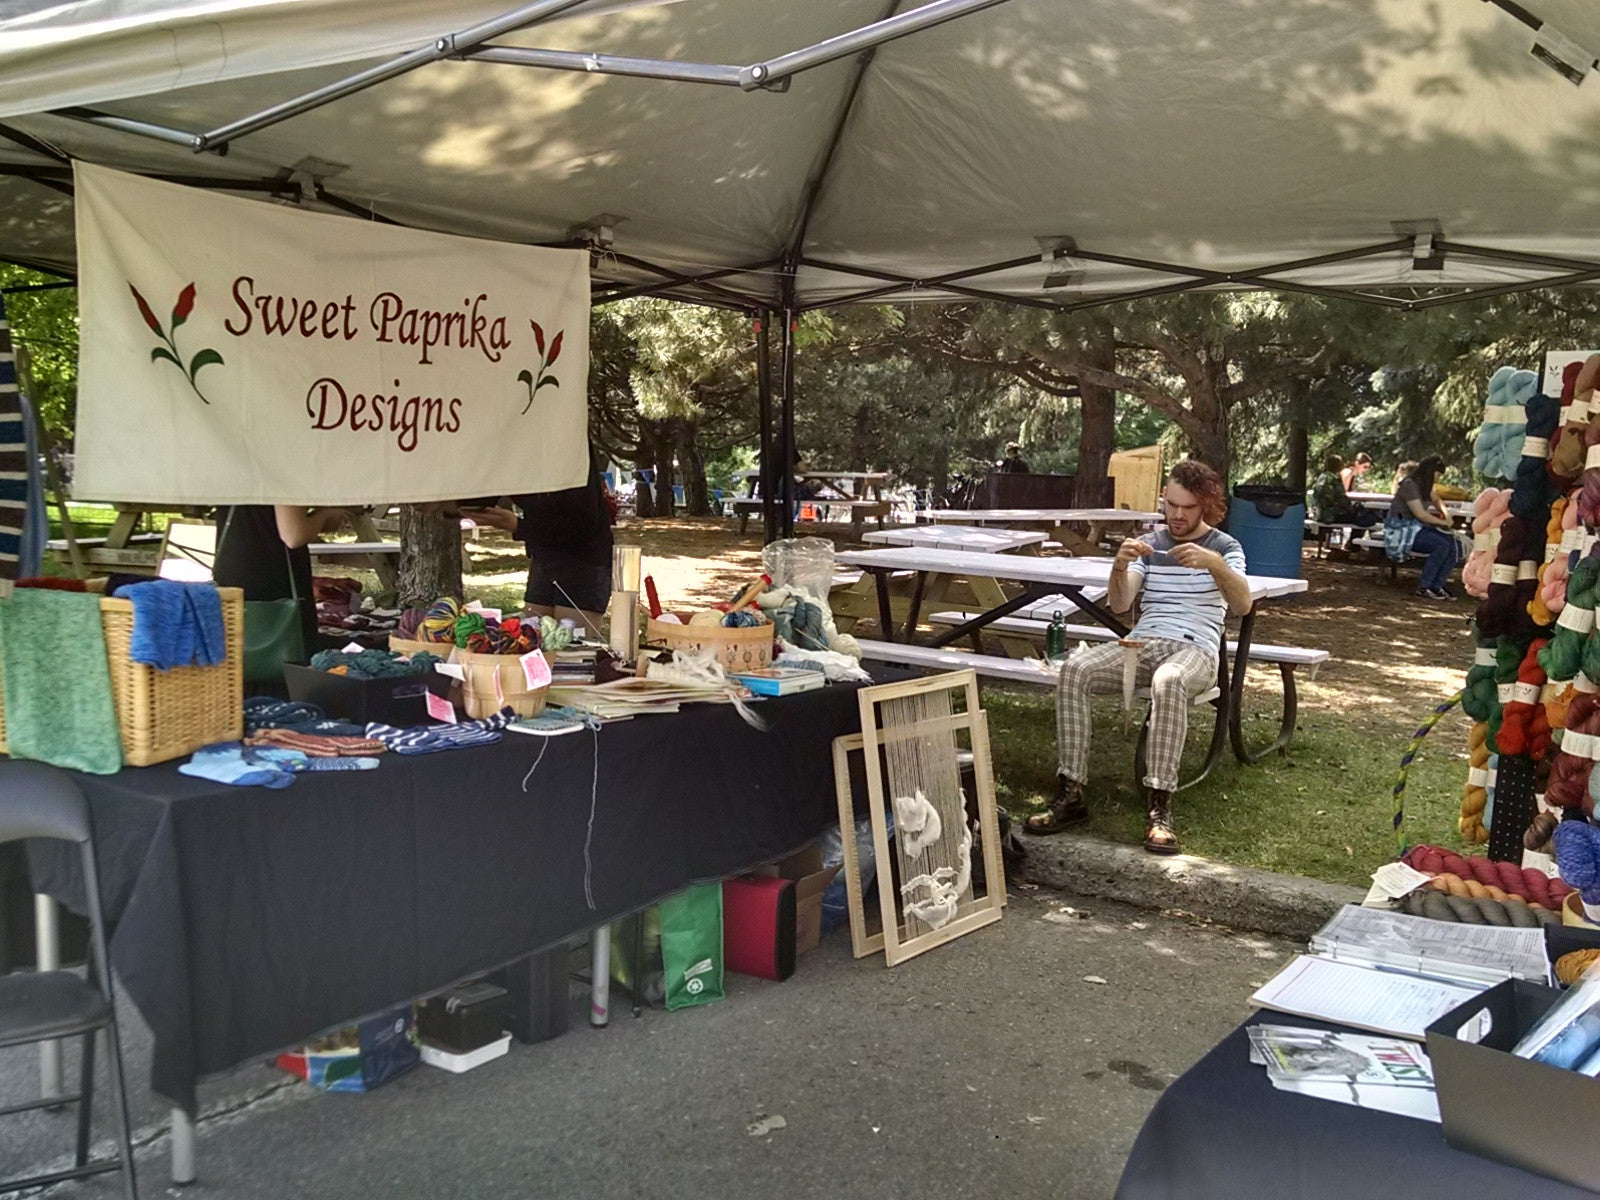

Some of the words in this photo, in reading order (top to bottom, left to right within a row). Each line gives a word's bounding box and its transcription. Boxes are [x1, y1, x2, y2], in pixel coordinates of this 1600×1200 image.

[224, 275, 359, 340] Sweet
[369, 291, 512, 365] Paprika
[306, 377, 462, 453] Designs
